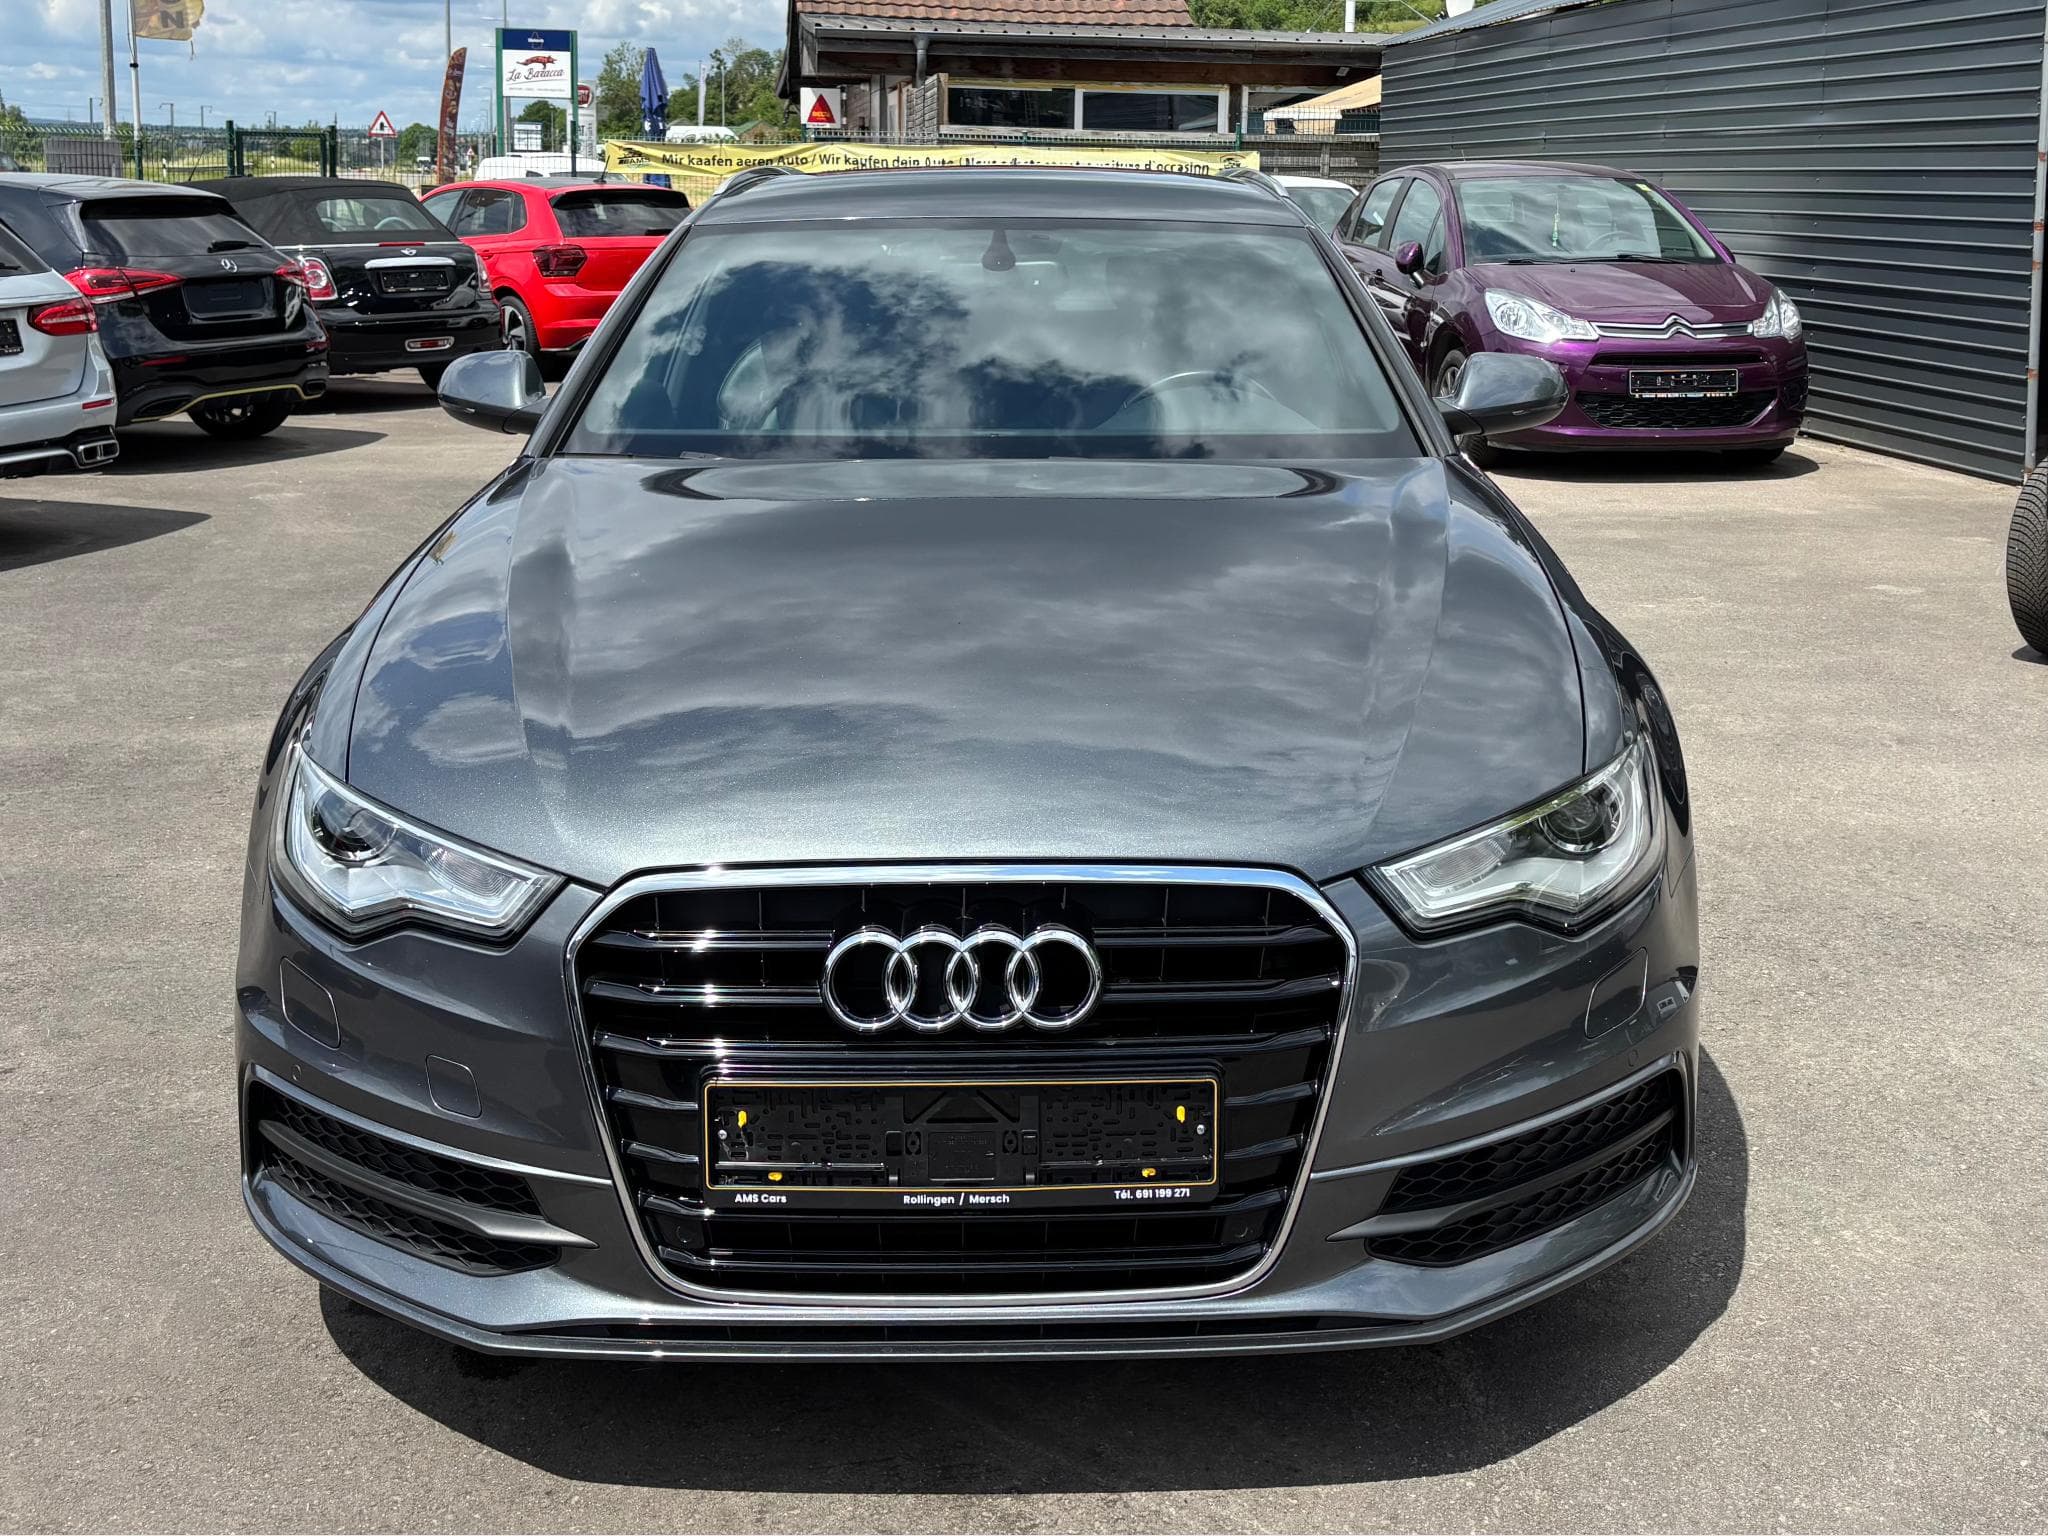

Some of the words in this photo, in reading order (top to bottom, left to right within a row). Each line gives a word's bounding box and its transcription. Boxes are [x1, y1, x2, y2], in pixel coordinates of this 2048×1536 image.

[506, 69, 521, 81] La
[662, 154, 684, 165] Mir
[688, 154, 732, 166] kaafen
[736, 157, 773, 167] aeren
[777, 155, 808, 165] Auto
[811, 154, 816, 165] /
[818, 154, 841, 165] Wir
[844, 154, 889, 169] kaufen
[892, 156, 920, 167] dein
[734, 1193, 759, 1203] AMS
[761, 1193, 787, 1203] Cars
[903, 1194, 955, 1207] Rollingen
[959, 1192, 965, 1205] /
[969, 1194, 1010, 1204] Mersch
[1136, 1189, 1153, 1199] 691
[1155, 1188, 1172, 1198] 199
[1174, 1188, 1190, 1197] 271
